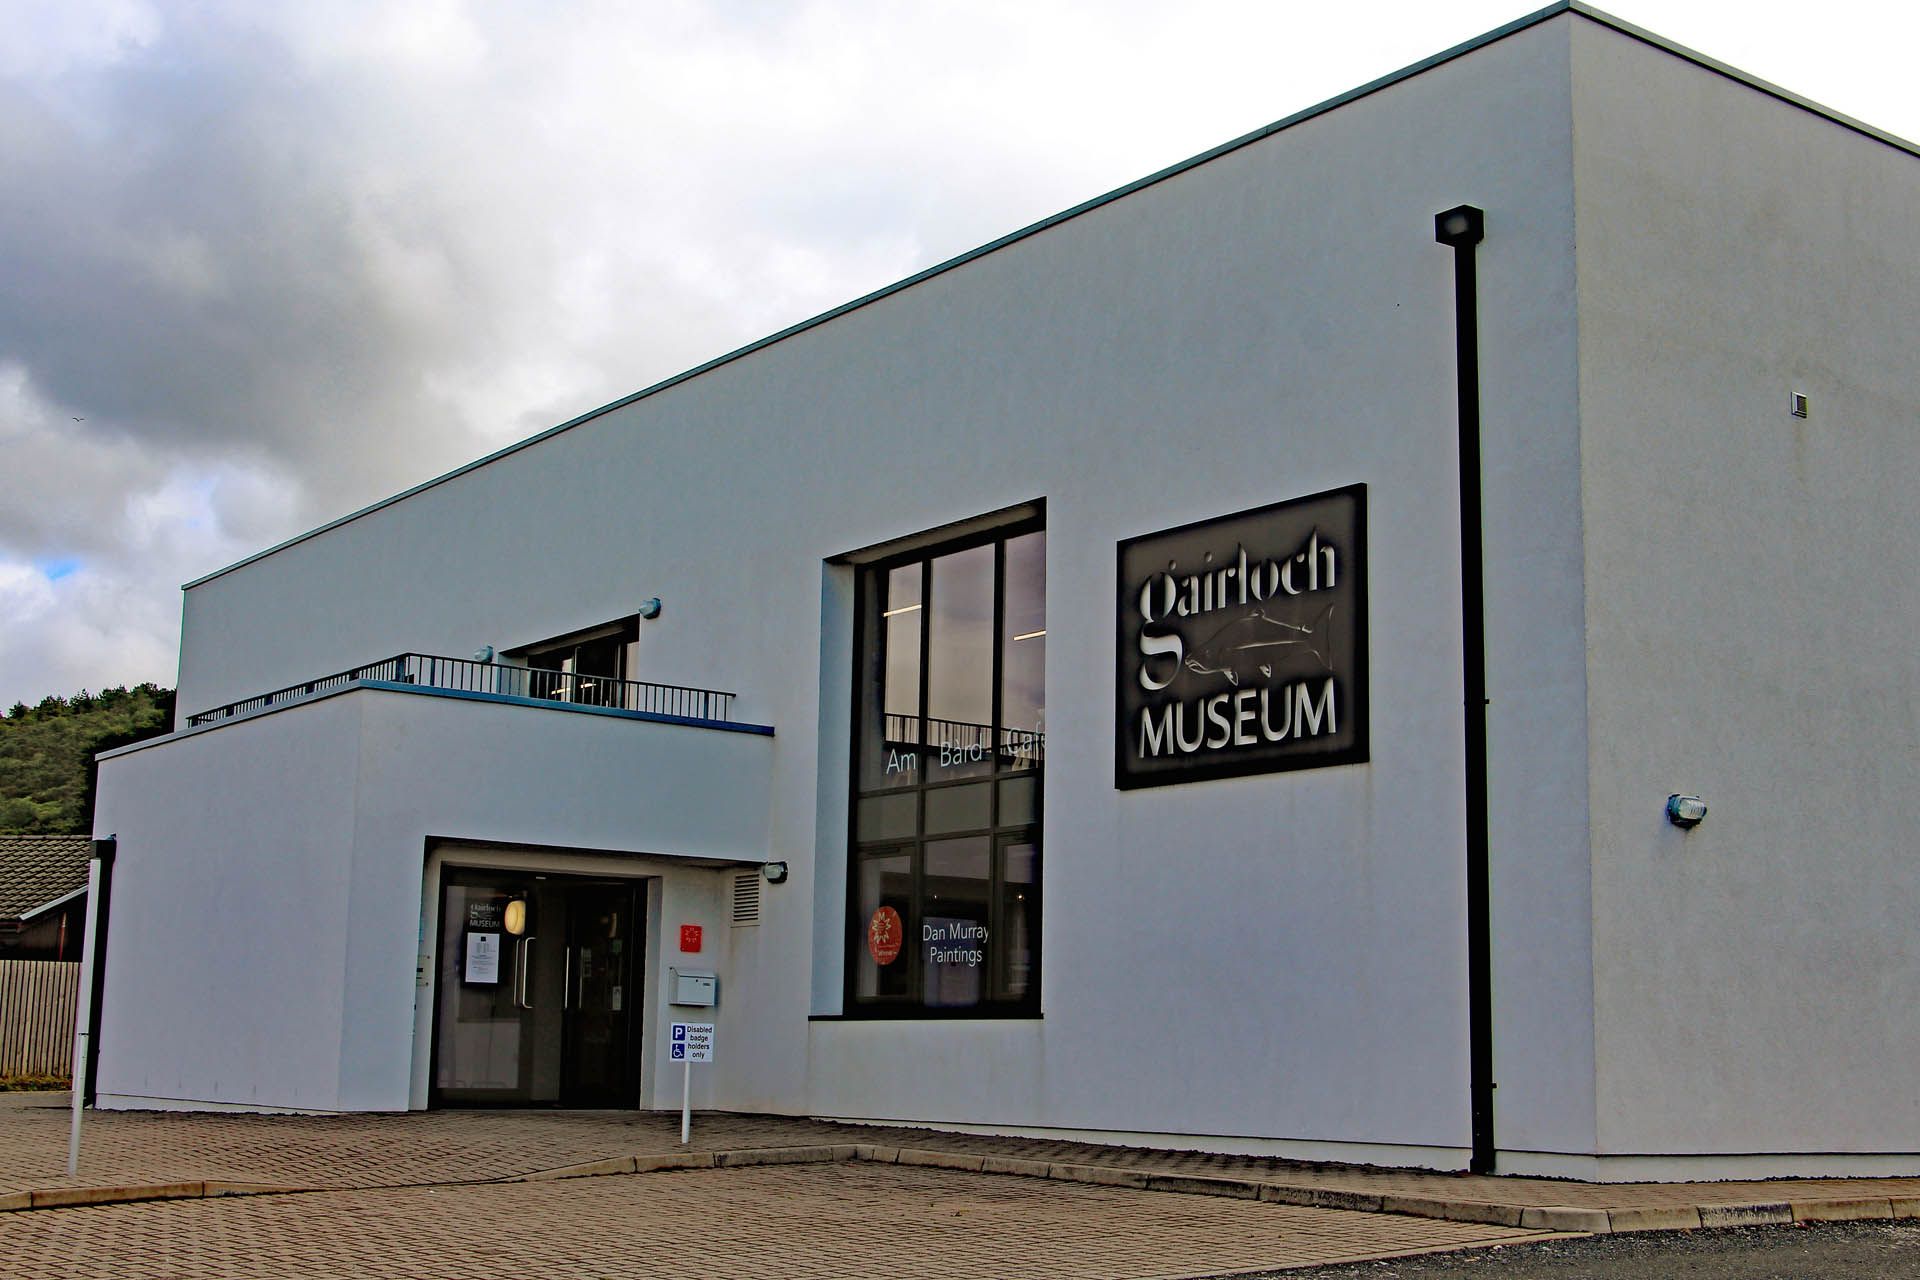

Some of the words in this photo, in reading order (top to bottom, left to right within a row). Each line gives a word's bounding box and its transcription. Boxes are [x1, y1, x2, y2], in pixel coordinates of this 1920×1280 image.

[1138, 676, 1337, 758] MUSEUM
[886, 748, 917, 774] Am
[940, 732, 983, 767] Bàrd
[922, 924, 946, 941] Dan
[949, 922, 989, 943] Murray
[930, 946, 983, 967] Paintings
[692, 1051, 704, 1059] only
